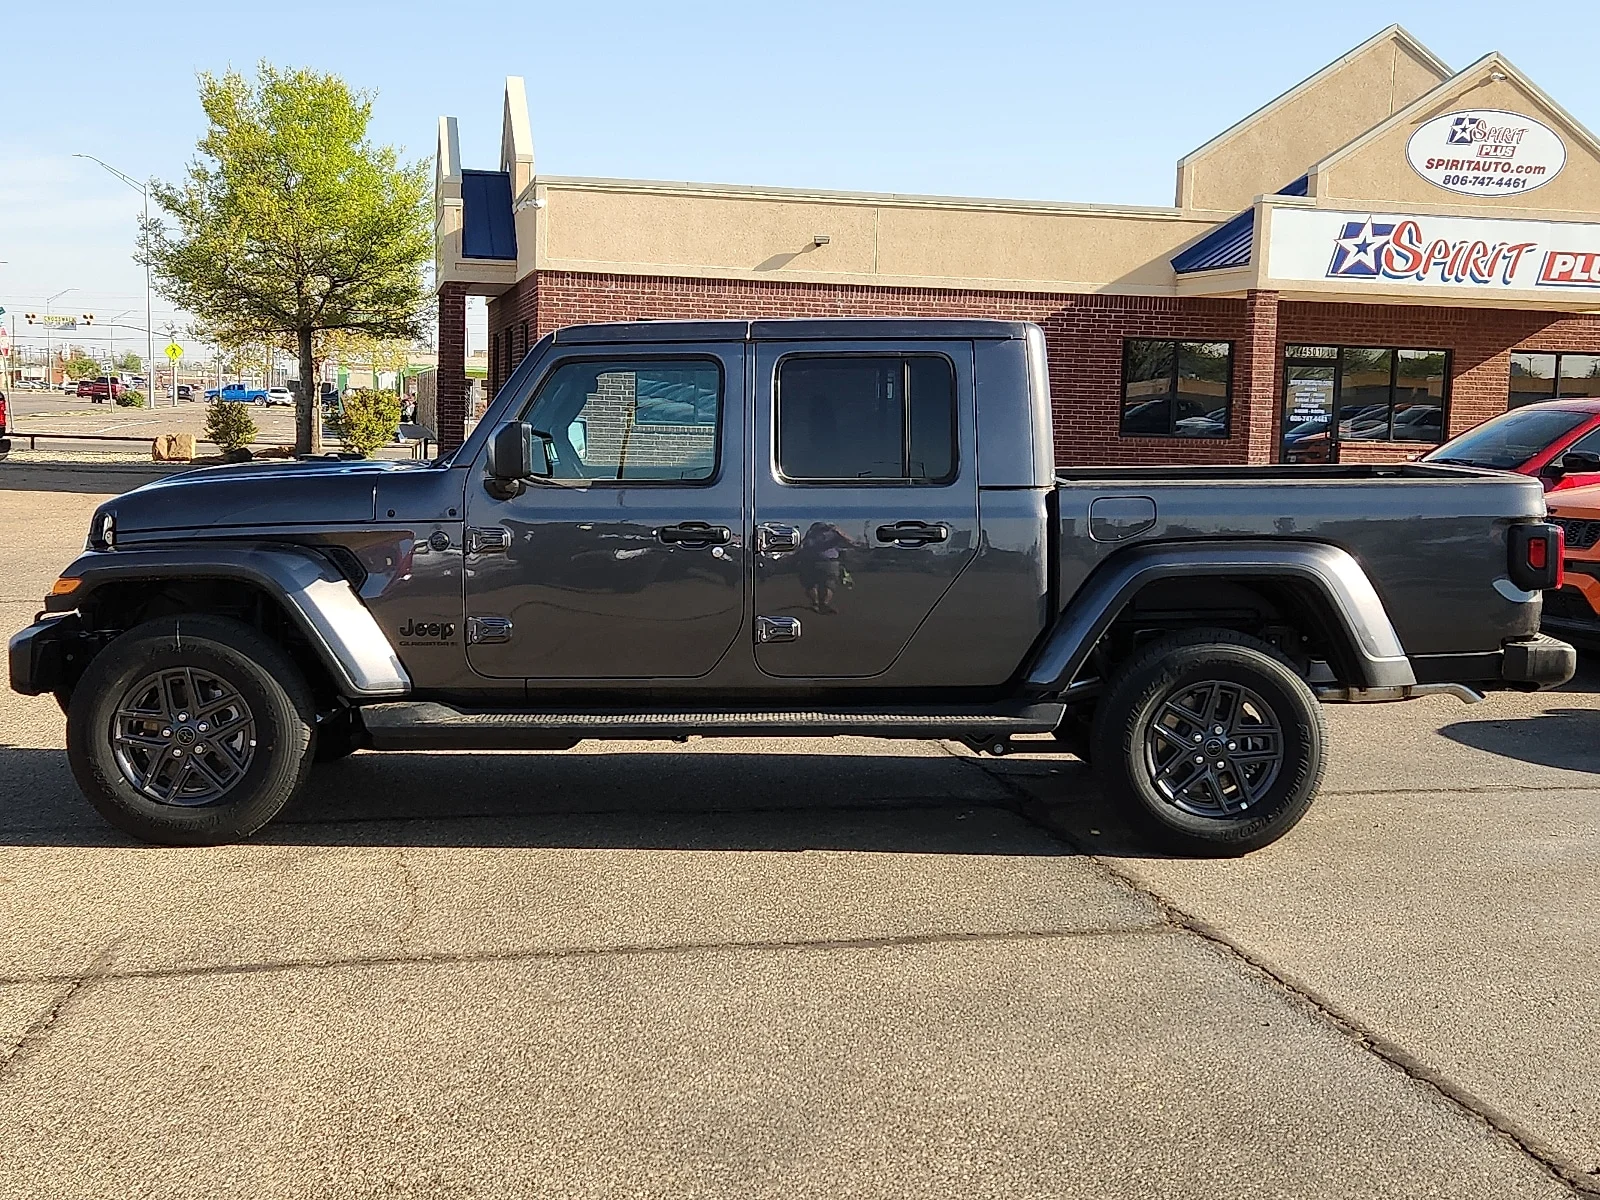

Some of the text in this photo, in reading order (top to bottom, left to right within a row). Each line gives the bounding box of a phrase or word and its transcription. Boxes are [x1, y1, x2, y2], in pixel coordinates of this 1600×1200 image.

[1480, 145, 1515, 157] PLUS
[1425, 158, 1546, 175] SPIRITAUTO.com
[1442, 175, 1528, 189] 806-747-4461
[399, 618, 456, 640] Jeep
